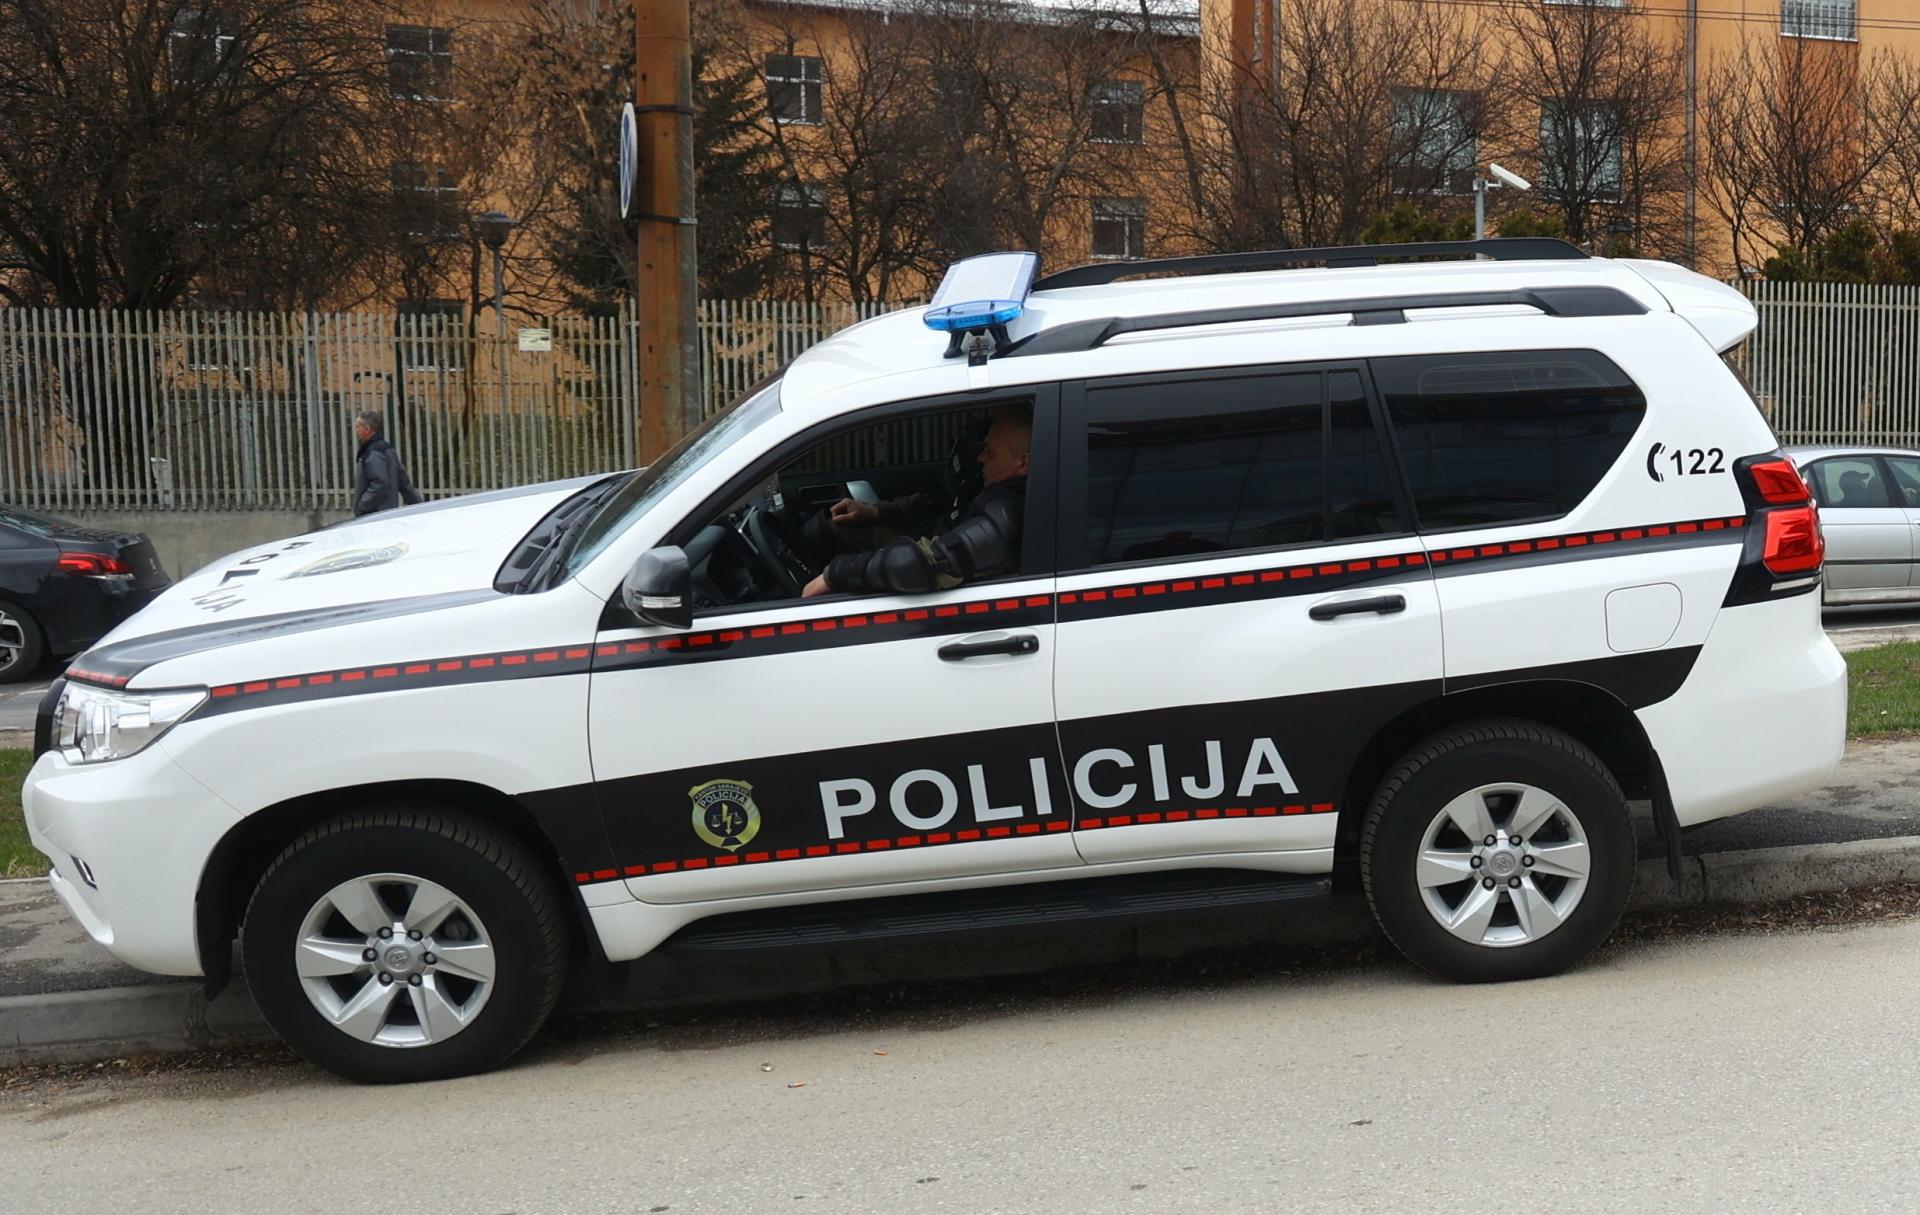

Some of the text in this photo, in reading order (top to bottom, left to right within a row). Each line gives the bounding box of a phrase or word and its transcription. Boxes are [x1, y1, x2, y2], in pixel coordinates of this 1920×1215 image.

[1670, 447, 1726, 476] 122
[699, 790, 746, 807] POLICIJA
[818, 737, 1300, 840] POLICIJA
